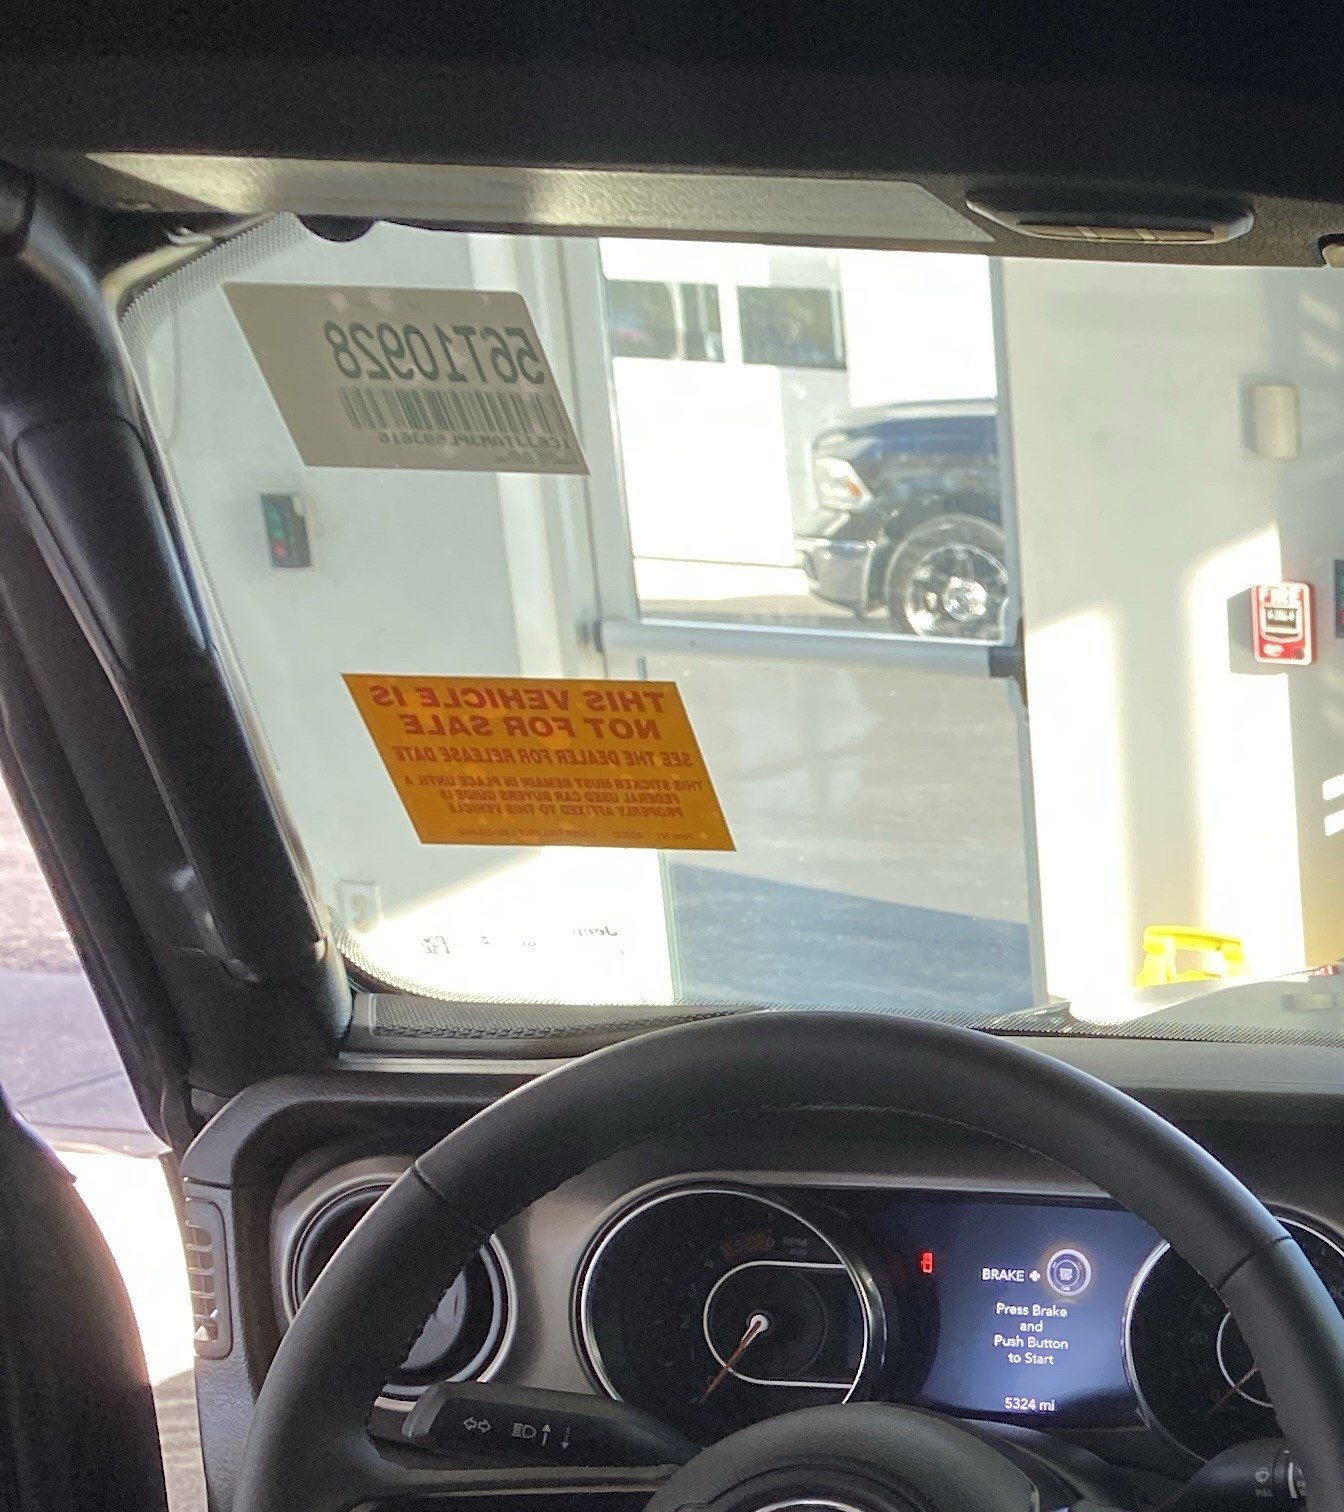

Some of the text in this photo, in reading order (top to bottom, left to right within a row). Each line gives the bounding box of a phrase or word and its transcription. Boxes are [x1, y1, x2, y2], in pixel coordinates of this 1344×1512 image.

[981, 1267, 1026, 1282] BRAKE
[996, 1302, 1069, 1318] Press Brake
[1019, 1319, 1045, 1333] and
[993, 1334, 1070, 1350] Push Button
[1008, 1352, 1055, 1366] to Start
[1004, 1397, 1056, 1413] 5324 mi
